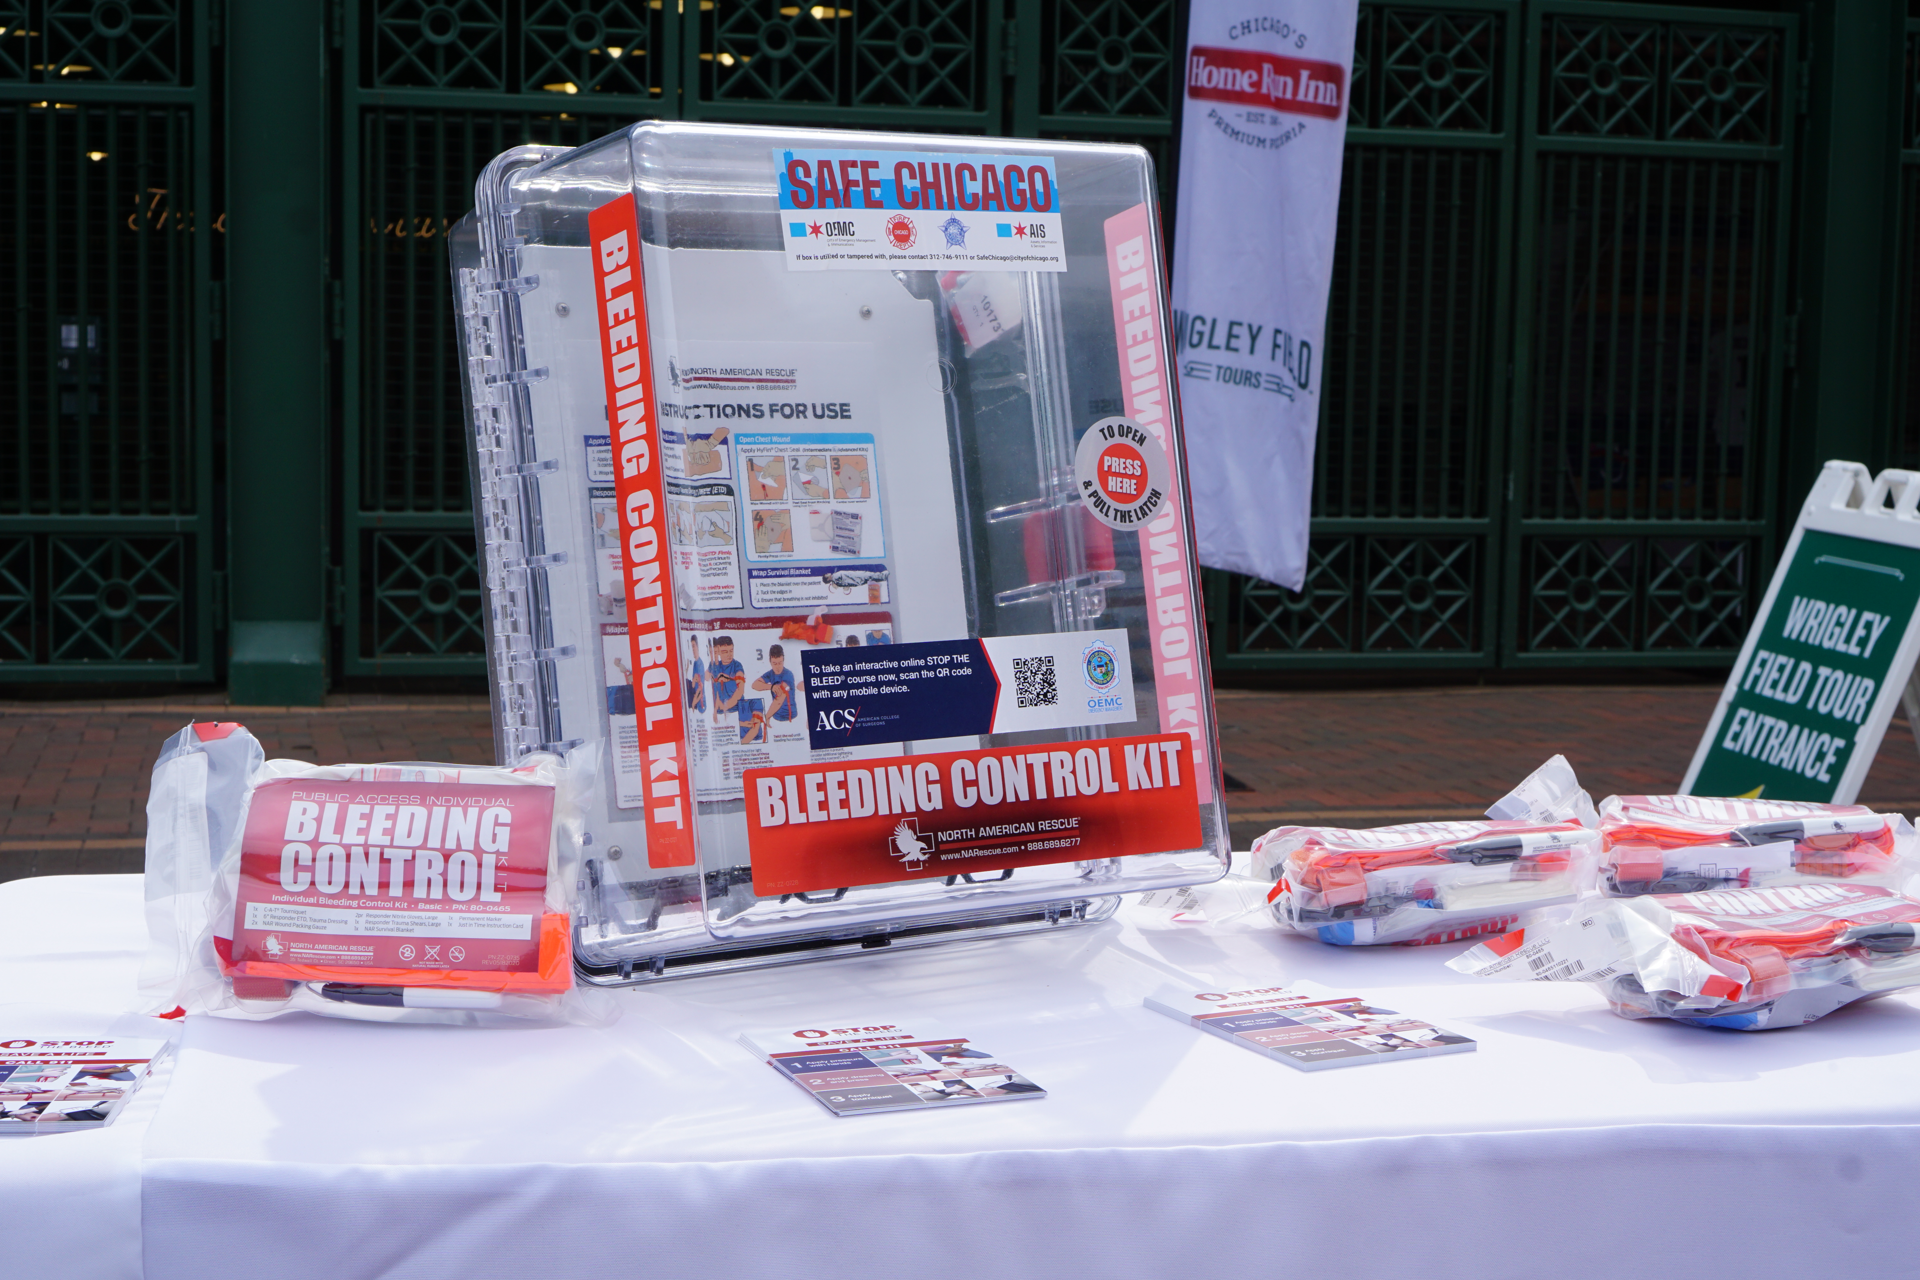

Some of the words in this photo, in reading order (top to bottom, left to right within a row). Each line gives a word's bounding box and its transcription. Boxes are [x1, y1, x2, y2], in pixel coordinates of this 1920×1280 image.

[1190, 56, 1258, 94] Home
[1296, 69, 1338, 107] Inn
[1208, 108, 1267, 149] PREMIUM
[787, 159, 884, 209] SAFE
[893, 161, 1052, 213] CHICAGO
[825, 221, 855, 238] OEMC
[1029, 223, 1046, 239] AIS
[846, 253, 873, 261] tampered
[889, 253, 907, 261] please
[930, 253, 968, 261] 312-746-9111
[977, 254, 1059, 262] SafeChicago@cityofchicago.org
[600, 229, 650, 479] BLEEDING
[720, 368, 762, 377] AMERICAN
[765, 369, 797, 377] RESCUE
[1216, 364, 1262, 389] TOURS
[769, 402, 808, 419] FOR
[812, 402, 852, 420] USE
[1099, 424, 1116, 441] TO
[1118, 424, 1147, 447] OPEN
[748, 459, 754, 471] 1
[791, 458, 800, 471] 2
[832, 458, 841, 471] 3
[1104, 456, 1142, 477] PRESS
[1108, 476, 1137, 496] HERE
[1083, 480, 1093, 490] &
[1088, 489, 1111, 518] PULL
[1113, 507, 1134, 524] THE
[1134, 488, 1162, 522] LATCH
[754, 511, 764, 523] 4
[626, 489, 674, 731] CONTROL
[1782, 595, 1891, 659] WRIGLEY
[755, 649, 764, 661] 3
[809, 664, 820, 674] To
[821, 663, 841, 673] take
[842, 664, 853, 672] an
[855, 659, 898, 670] interactive
[900, 658, 925, 668] online
[926, 656, 951, 666] STOP
[952, 654, 970, 663] THE
[847, 676, 876, 684] course
[878, 674, 898, 682] now,
[899, 671, 920, 680] scan
[921, 670, 935, 678] the
[936, 668, 950, 677] QR
[951, 667, 972, 676] code
[812, 690, 831, 699] with
[832, 690, 848, 699] any
[850, 686, 879, 696] mobile
[880, 684, 910, 694] device.
[1743, 649, 1812, 704] FIELD
[1806, 666, 1875, 725] TOUR
[1088, 697, 1123, 708] OEMC
[816, 708, 856, 731] ACS
[1722, 707, 1846, 783] ENTRANCE
[648, 741, 684, 830] KIT
[756, 762, 943, 827] BLEEDING
[951, 747, 1120, 806] CONTROL
[1124, 741, 1183, 790] KIT
[292, 791, 350, 803] PUBLIC
[355, 794, 420, 805] ACCESS
[426, 796, 515, 807] INDIVIDUAL
[284, 800, 512, 853] BLEEDING
[938, 828, 975, 842] NORTH
[978, 822, 1035, 838] AMERICAN
[1038, 818, 1079, 831] RESCUE
[940, 845, 1019, 861] www.NARescue.com
[1027, 838, 1081, 851] 888.689.6277
[280, 842, 502, 902] CONTROL
[497, 856, 508, 892] KIT
[272, 894, 317, 904] Individual
[319, 897, 359, 907] Bleeding
[360, 900, 393, 908] Control
[395, 901, 408, 909] Kit
[1683, 883, 1866, 916] CONTROL
[292, 922, 311, 930] Packing
[1582, 919, 1593, 928] MD
[314, 943, 348, 951] AMERICAN
[831, 1025, 896, 1034] STOP
